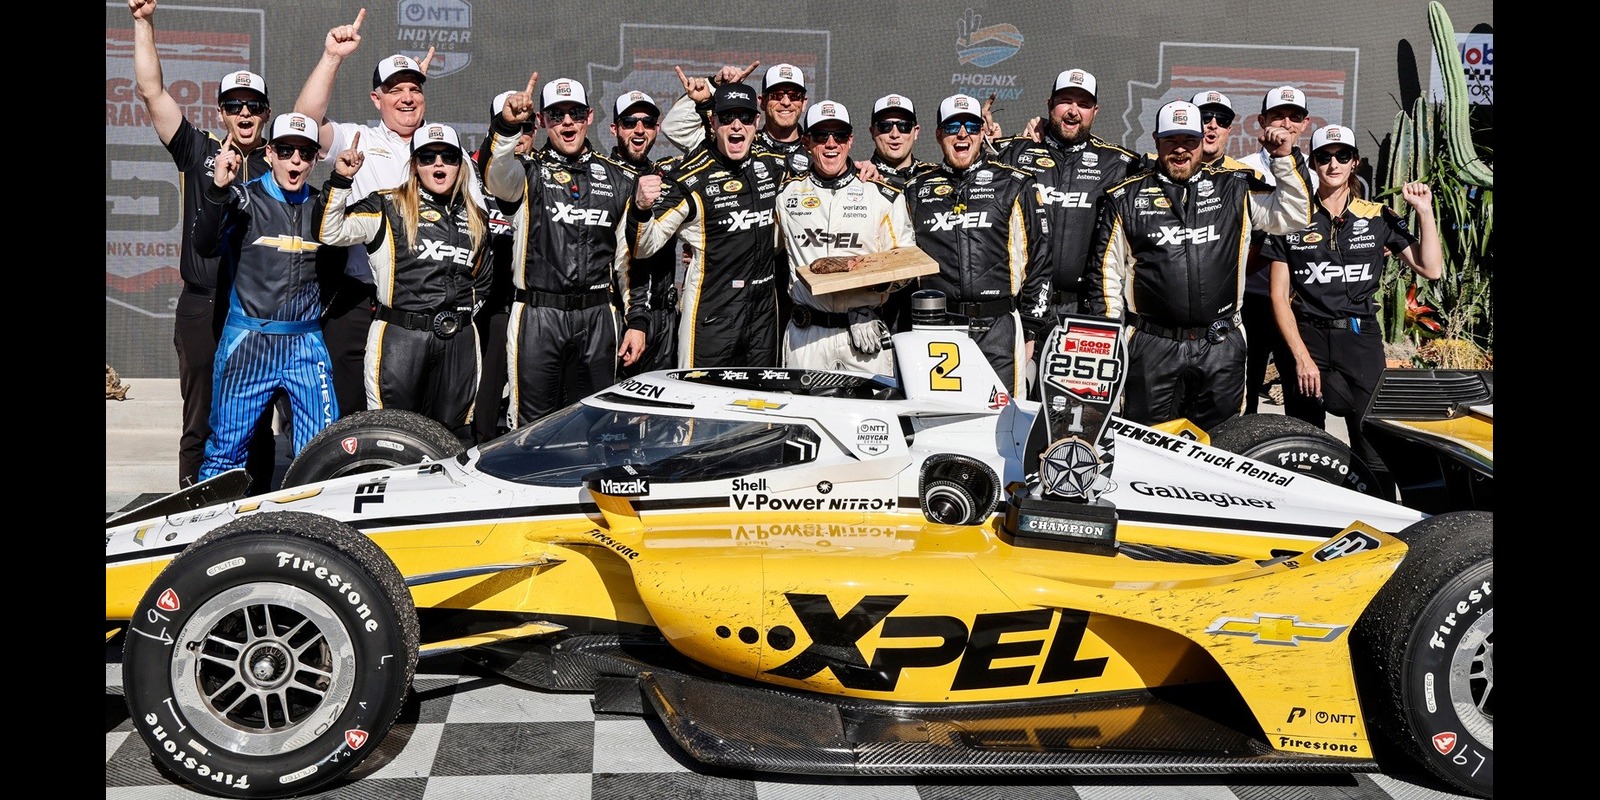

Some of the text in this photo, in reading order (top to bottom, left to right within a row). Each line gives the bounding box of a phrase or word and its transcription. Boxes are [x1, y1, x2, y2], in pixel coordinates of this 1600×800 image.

[428, 6, 465, 21] NTT
[397, 28, 472, 43] INDYCAR
[951, 73, 1018, 87] PHOENIX
[728, 91, 750, 100] XPEL
[590, 181, 613, 190] verizon
[591, 188, 613, 197] Astemo
[757, 183, 776, 192] verizon
[1034, 183, 1093, 208] XPEL
[1195, 196, 1221, 206] verizon
[551, 201, 613, 227] XPEL
[1197, 204, 1222, 214] Astemo
[727, 208, 775, 232] XPEL
[929, 211, 993, 232] XPEL
[800, 228, 863, 248] XPEL
[1155, 224, 1221, 246] XPEL
[1348, 234, 1375, 243] verizon
[417, 238, 474, 267] XPEL
[1349, 242, 1376, 250] Astemo
[1303, 261, 1374, 285] XPEL
[1079, 347, 1110, 356] RANCHERS
[1080, 340, 1111, 349] GOOD
[723, 370, 749, 380] XPEL
[763, 370, 791, 380] XPEL
[928, 341, 962, 392] 2
[1049, 353, 1121, 383] 250
[1068, 404, 1083, 432] 1
[1110, 419, 1295, 487] PENSKE Truck Rental
[1277, 451, 1368, 494] Firestone
[600, 479, 648, 494] Mazak
[731, 478, 767, 491] Shell
[732, 494, 828, 510] V-Power
[1129, 481, 1277, 510] Gallagher
[1029, 520, 1104, 536] CHAMPION
[583, 528, 640, 560] Firestone
[208, 558, 244, 576] ENLITEN
[276, 551, 379, 632] Firestone
[764, 592, 1110, 692] XPEL
[1426, 673, 1437, 712] ENLITEN
[1330, 714, 1356, 724] NTT
[145, 712, 251, 790] Firestone
[1279, 736, 1358, 753] Firestone
